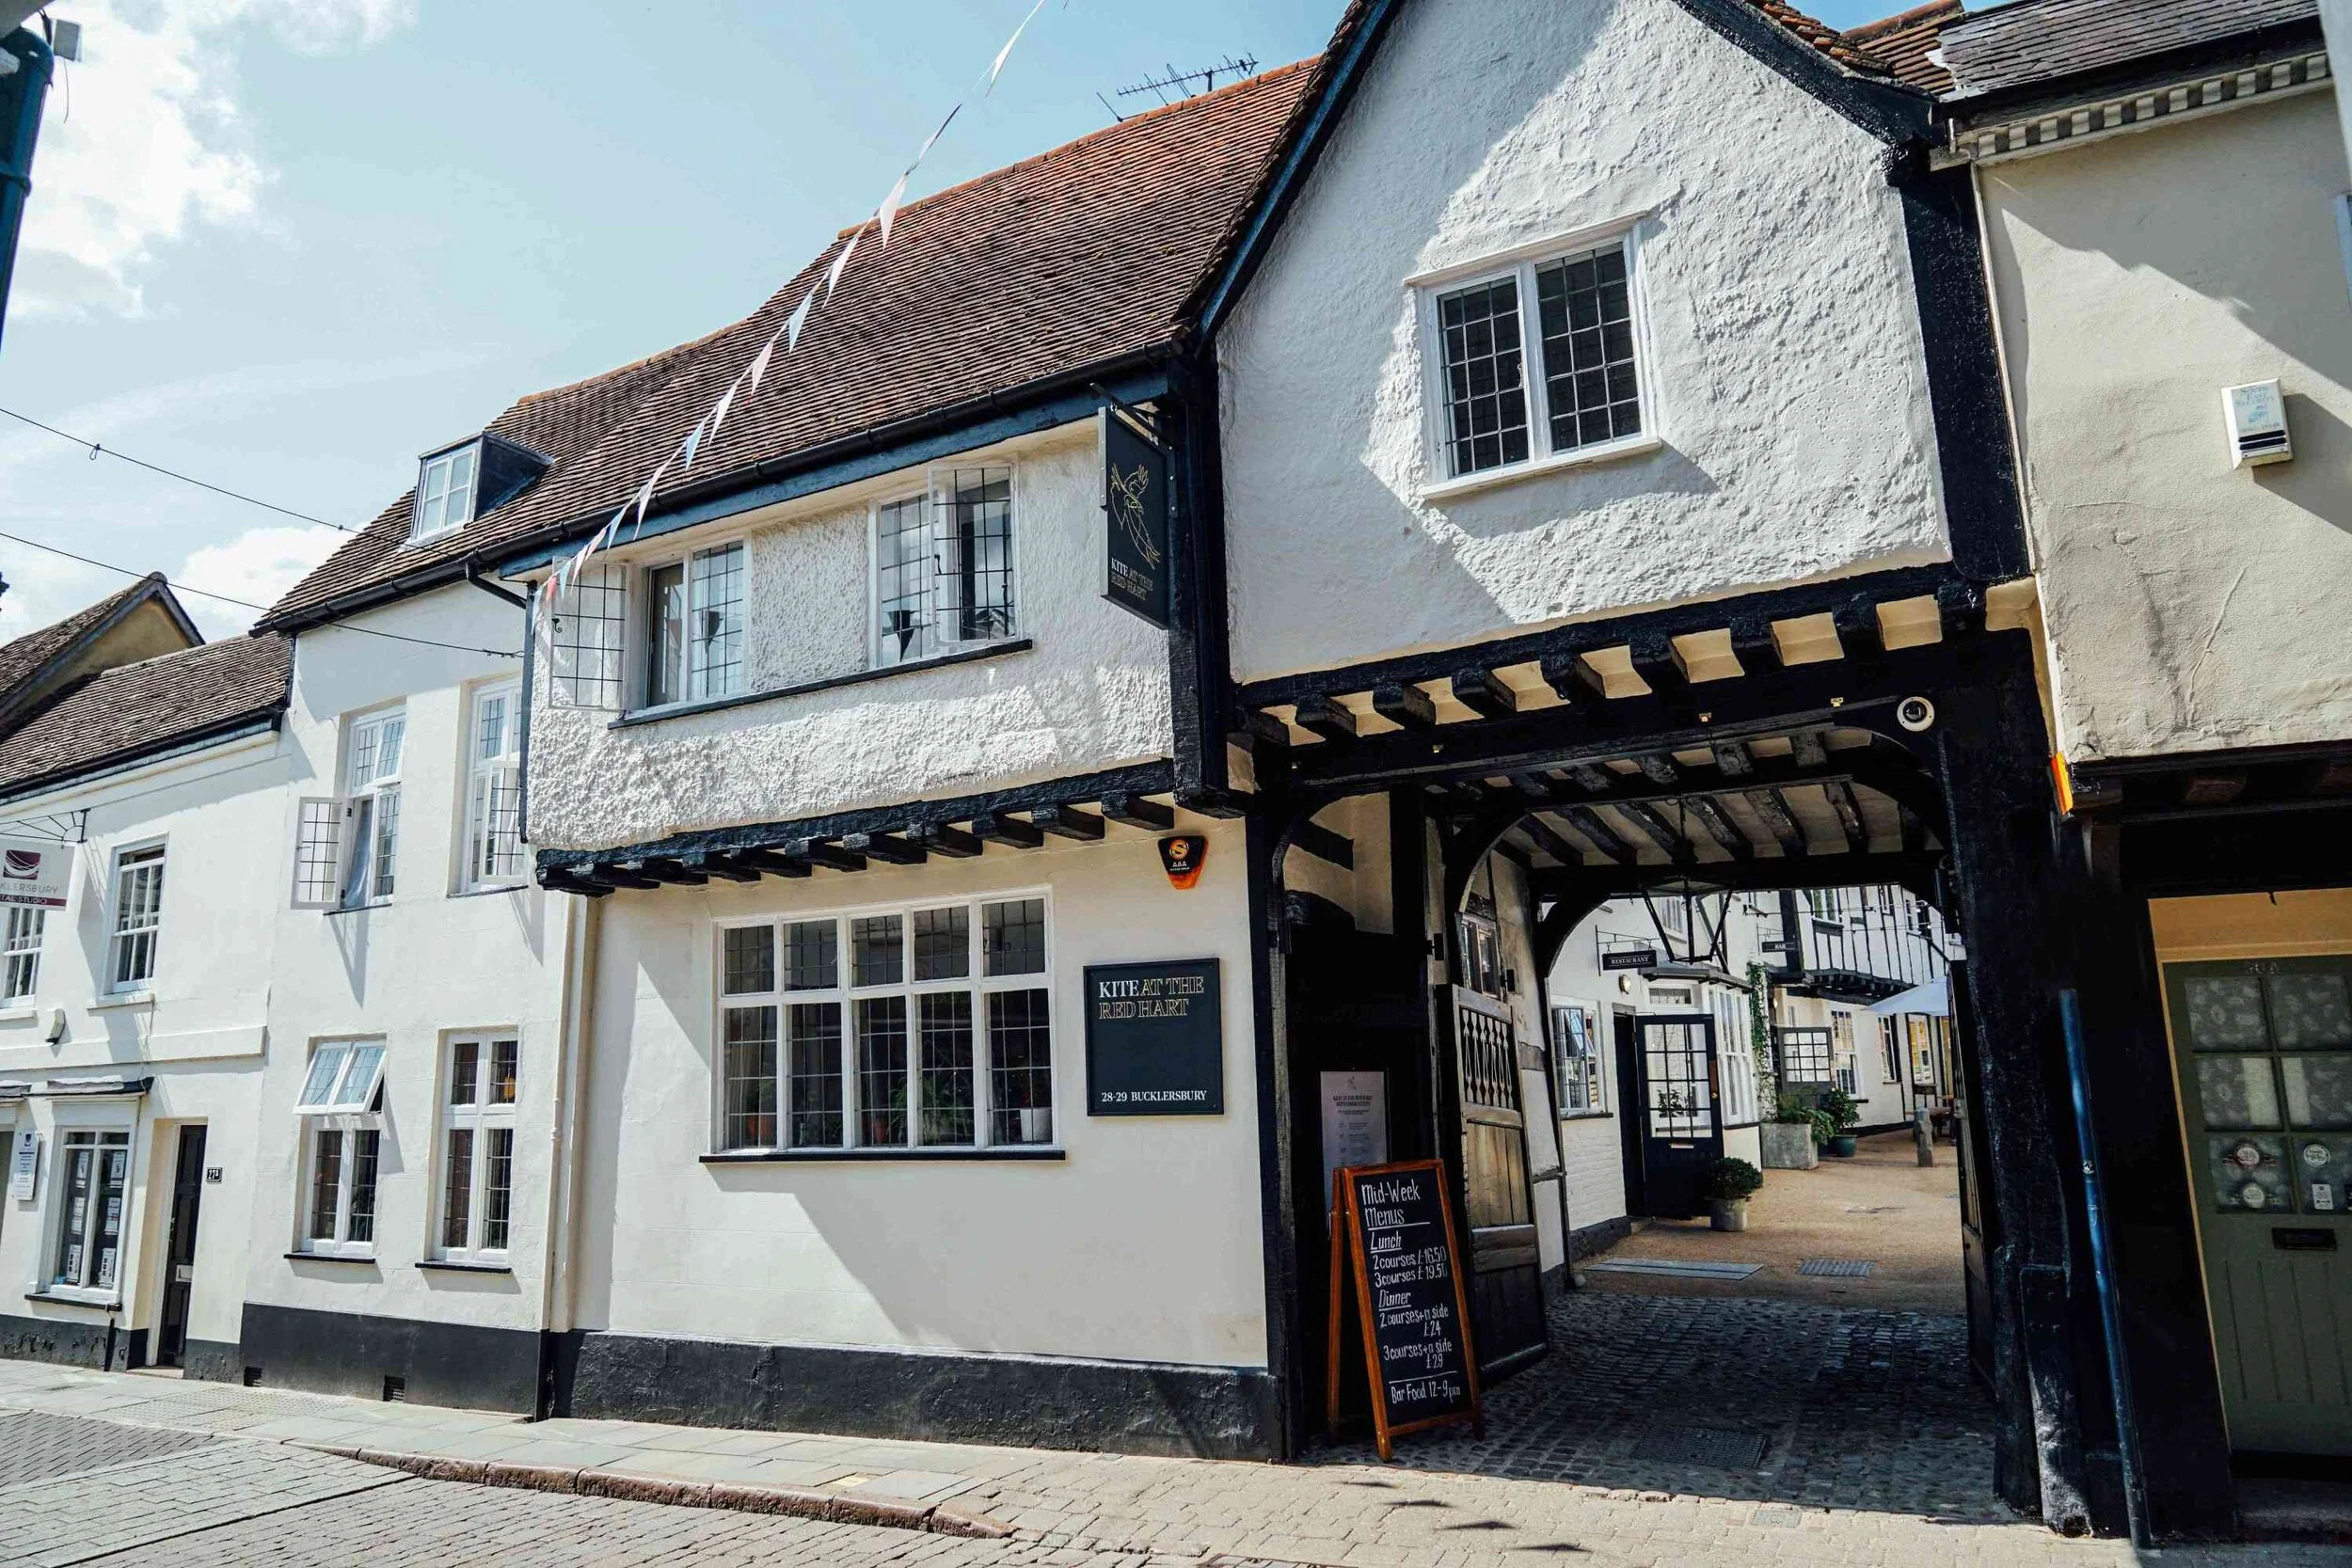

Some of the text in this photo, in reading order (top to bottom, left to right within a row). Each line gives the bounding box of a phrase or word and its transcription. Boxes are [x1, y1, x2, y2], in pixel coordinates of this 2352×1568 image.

[1111, 557, 1129, 578] KITE
[18, 895, 48, 905] STUDIO
[1099, 975, 1204, 998] KITE AT THE
[1099, 998, 1189, 1020] RED HART
[1101, 1090, 1207, 1102] 28-29 BUCKLERSBURY
[1360, 1178, 1421, 1205] Mid-Week
[1364, 1206, 1405, 1227] Menus
[1370, 1230, 1402, 1250] Lunch
[1378, 1290, 1411, 1307] Dinner
[1431, 1303, 1449, 1319] side
[1435, 1338, 1453, 1354] side
[1391, 1386, 1406, 1403] Bar
[1406, 1381, 1427, 1401] Food
